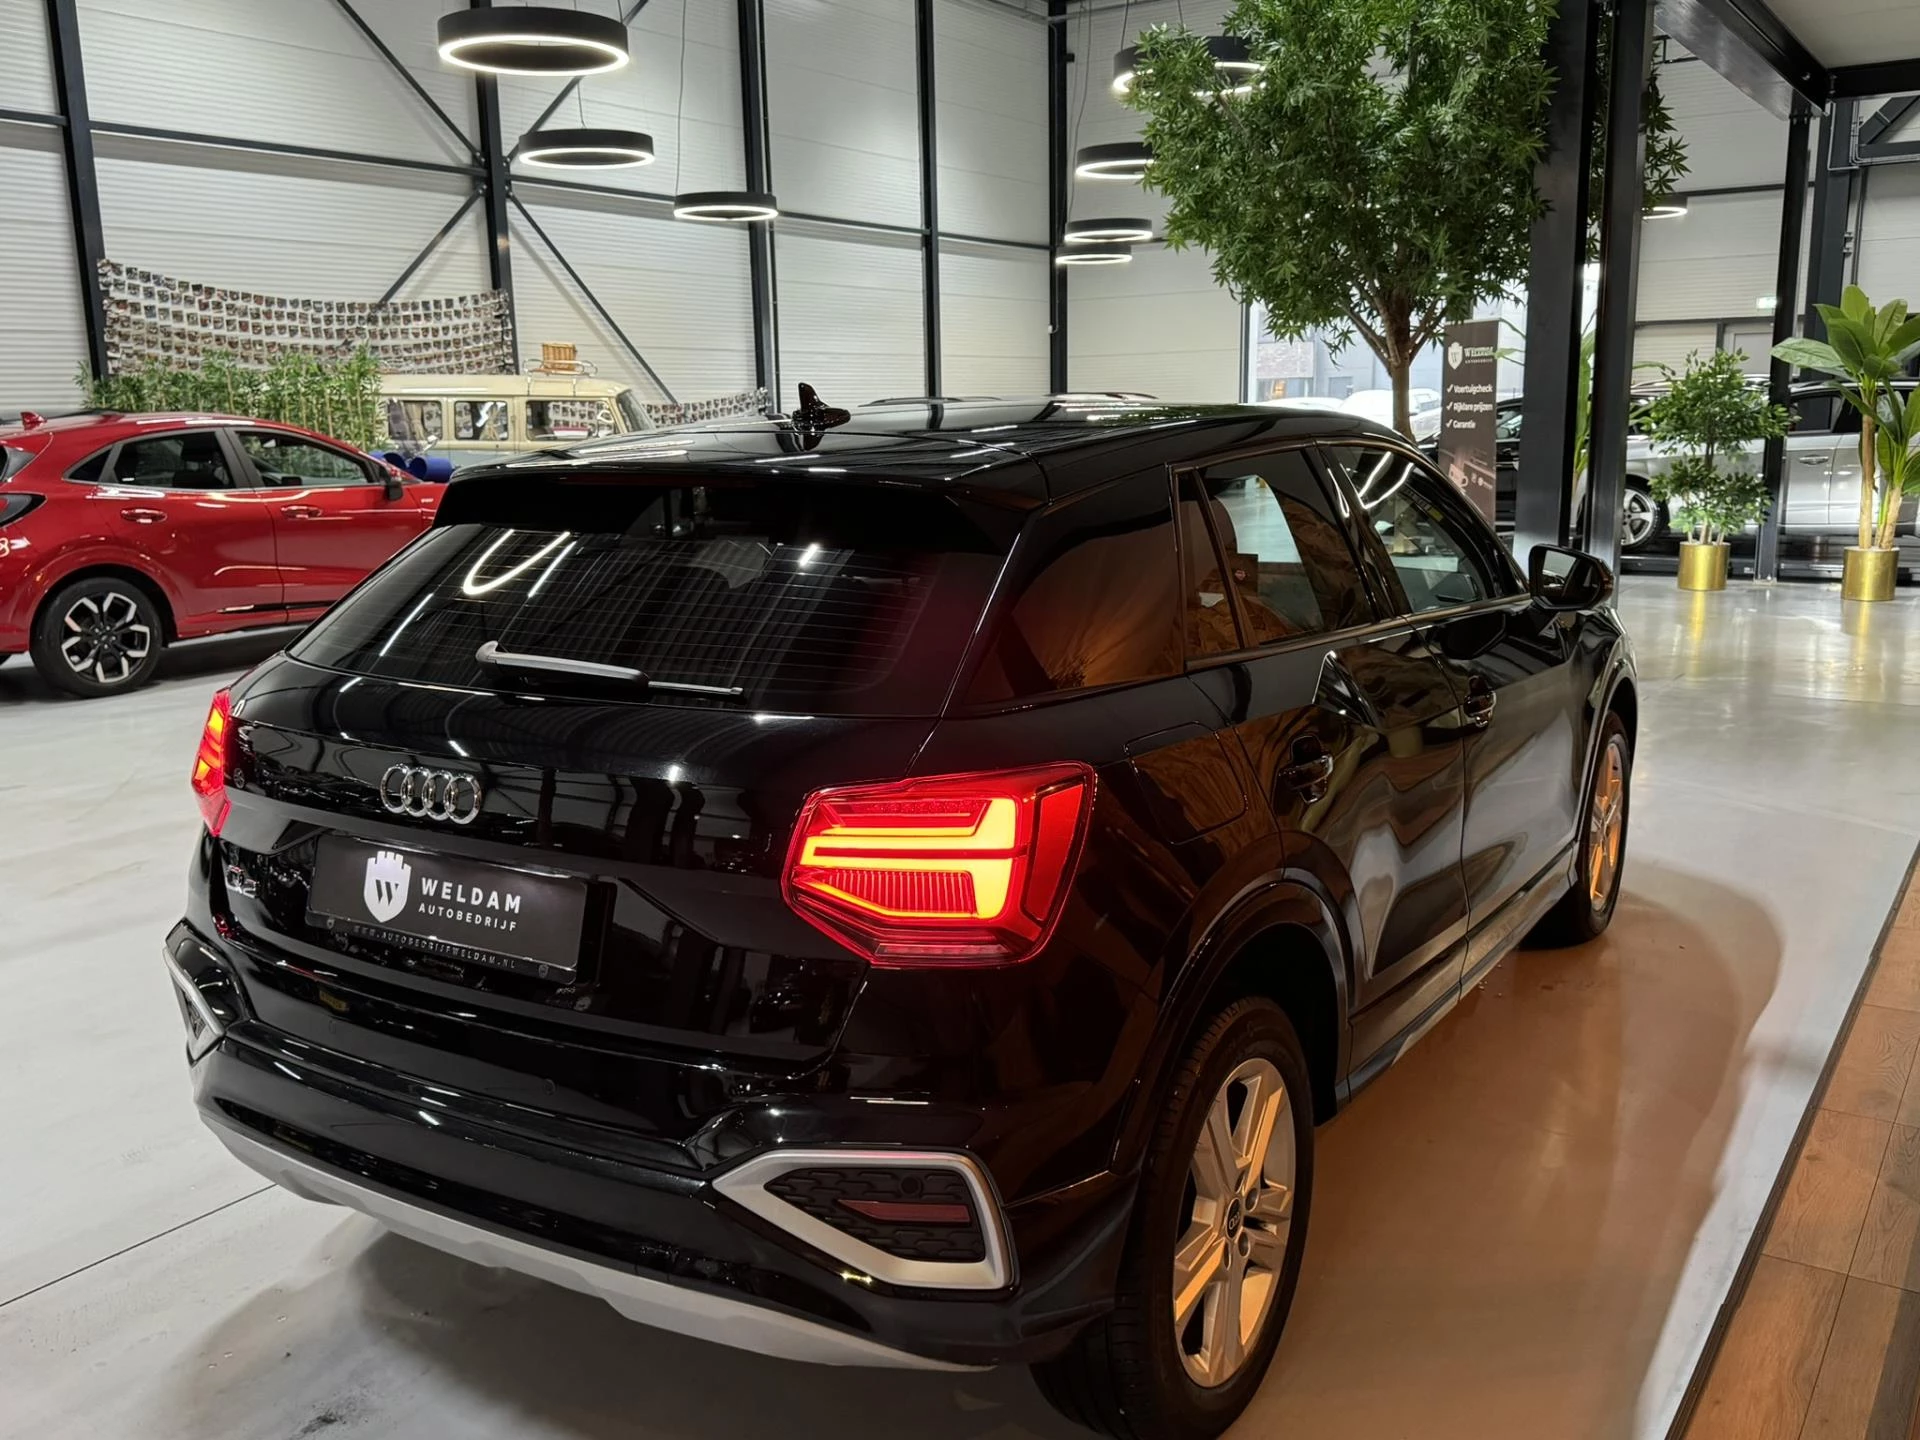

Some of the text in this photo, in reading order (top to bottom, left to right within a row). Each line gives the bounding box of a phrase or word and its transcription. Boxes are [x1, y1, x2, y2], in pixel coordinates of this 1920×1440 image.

[1453, 384, 1493, 395] Voertuigcheck
[1453, 420, 1476, 429] Garantie
[421, 877, 521, 914] WELDAM
[418, 903, 517, 931] AUTOBEDRIJF
